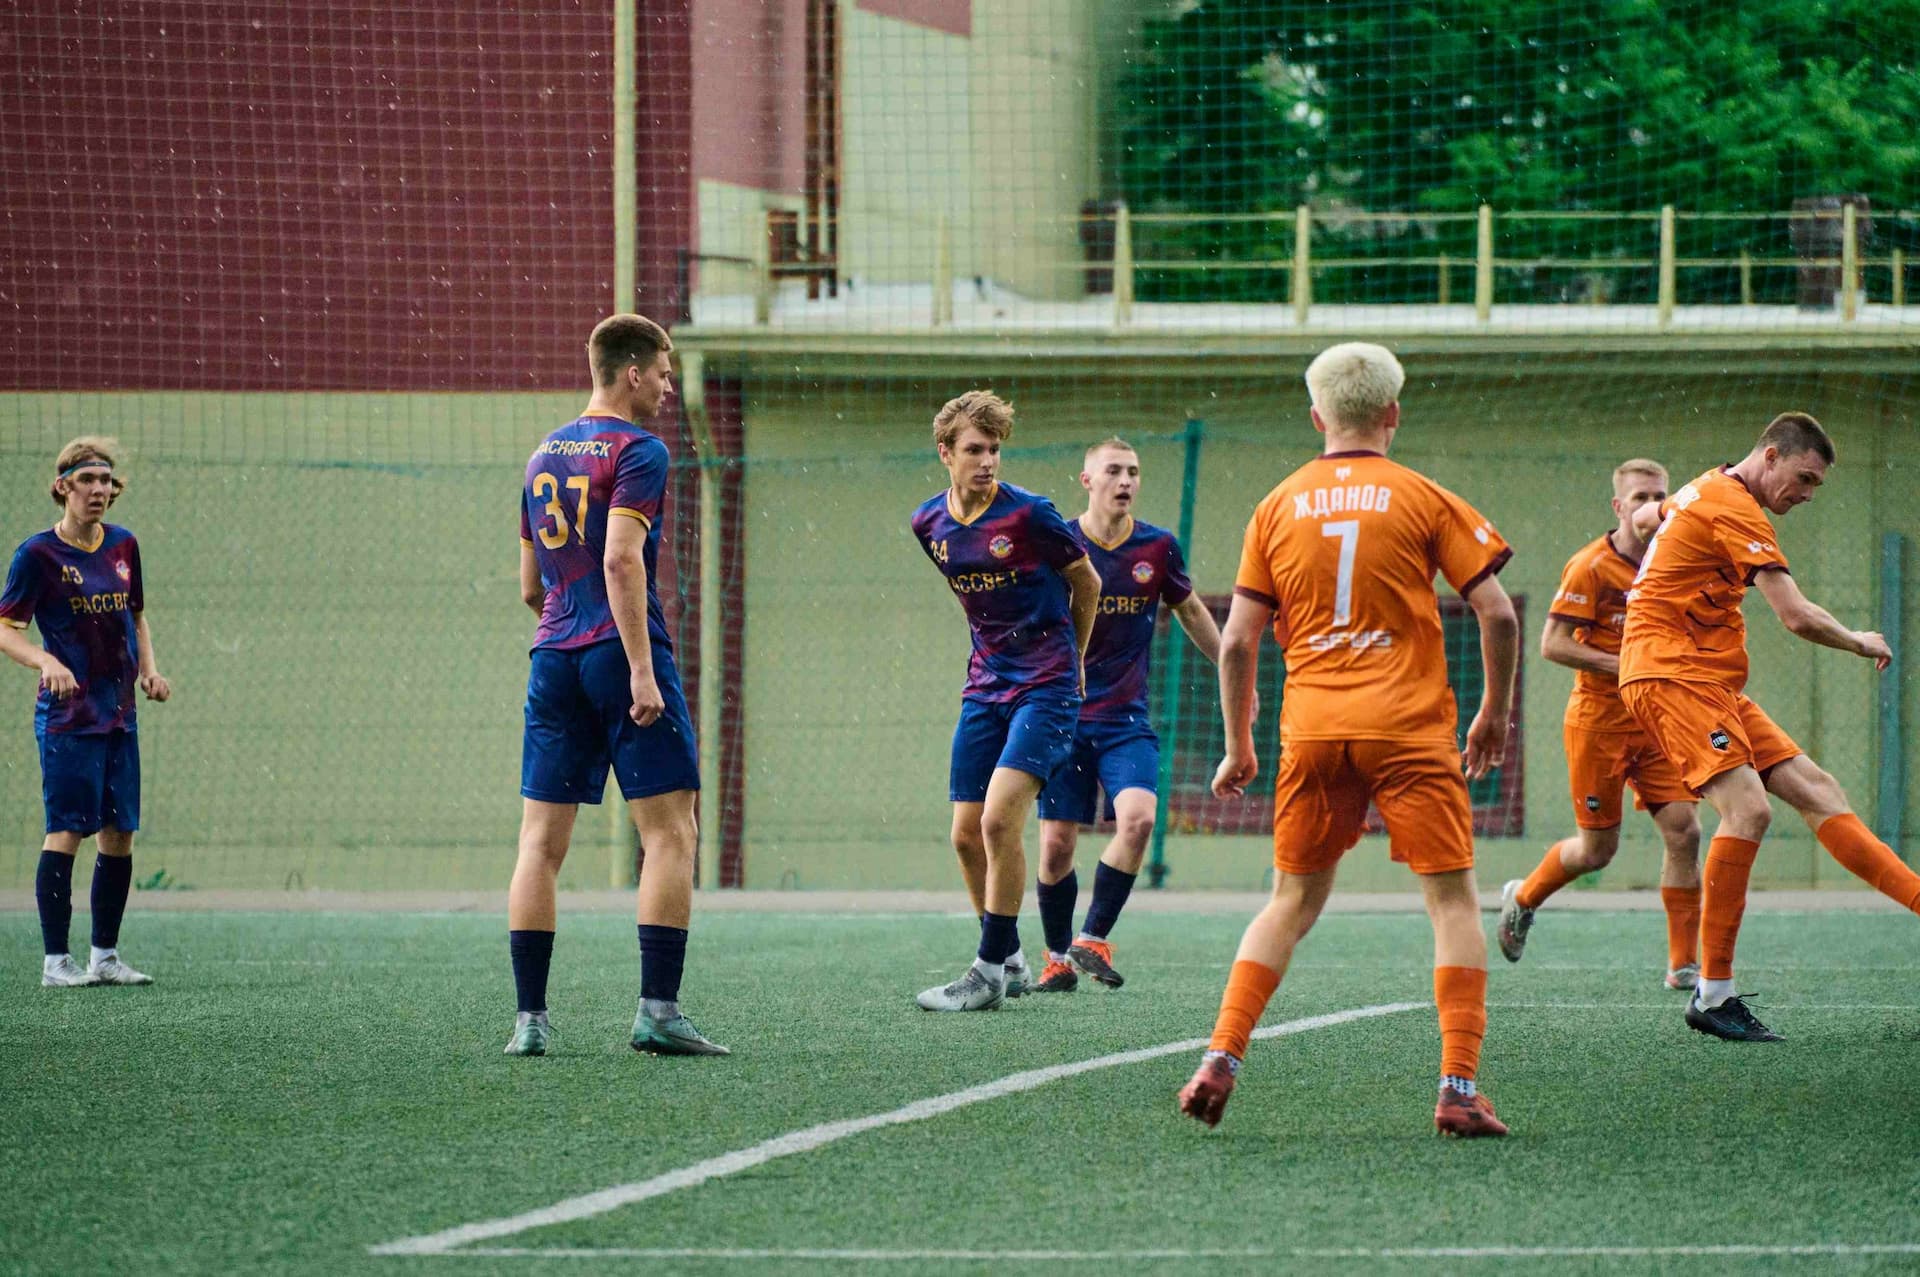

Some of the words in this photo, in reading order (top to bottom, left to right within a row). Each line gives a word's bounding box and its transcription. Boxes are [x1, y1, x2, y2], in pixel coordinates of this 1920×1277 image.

[532, 472, 591, 550] 37
[1293, 484, 1393, 520] ЖДАНОВ
[1321, 519, 1360, 628] 7
